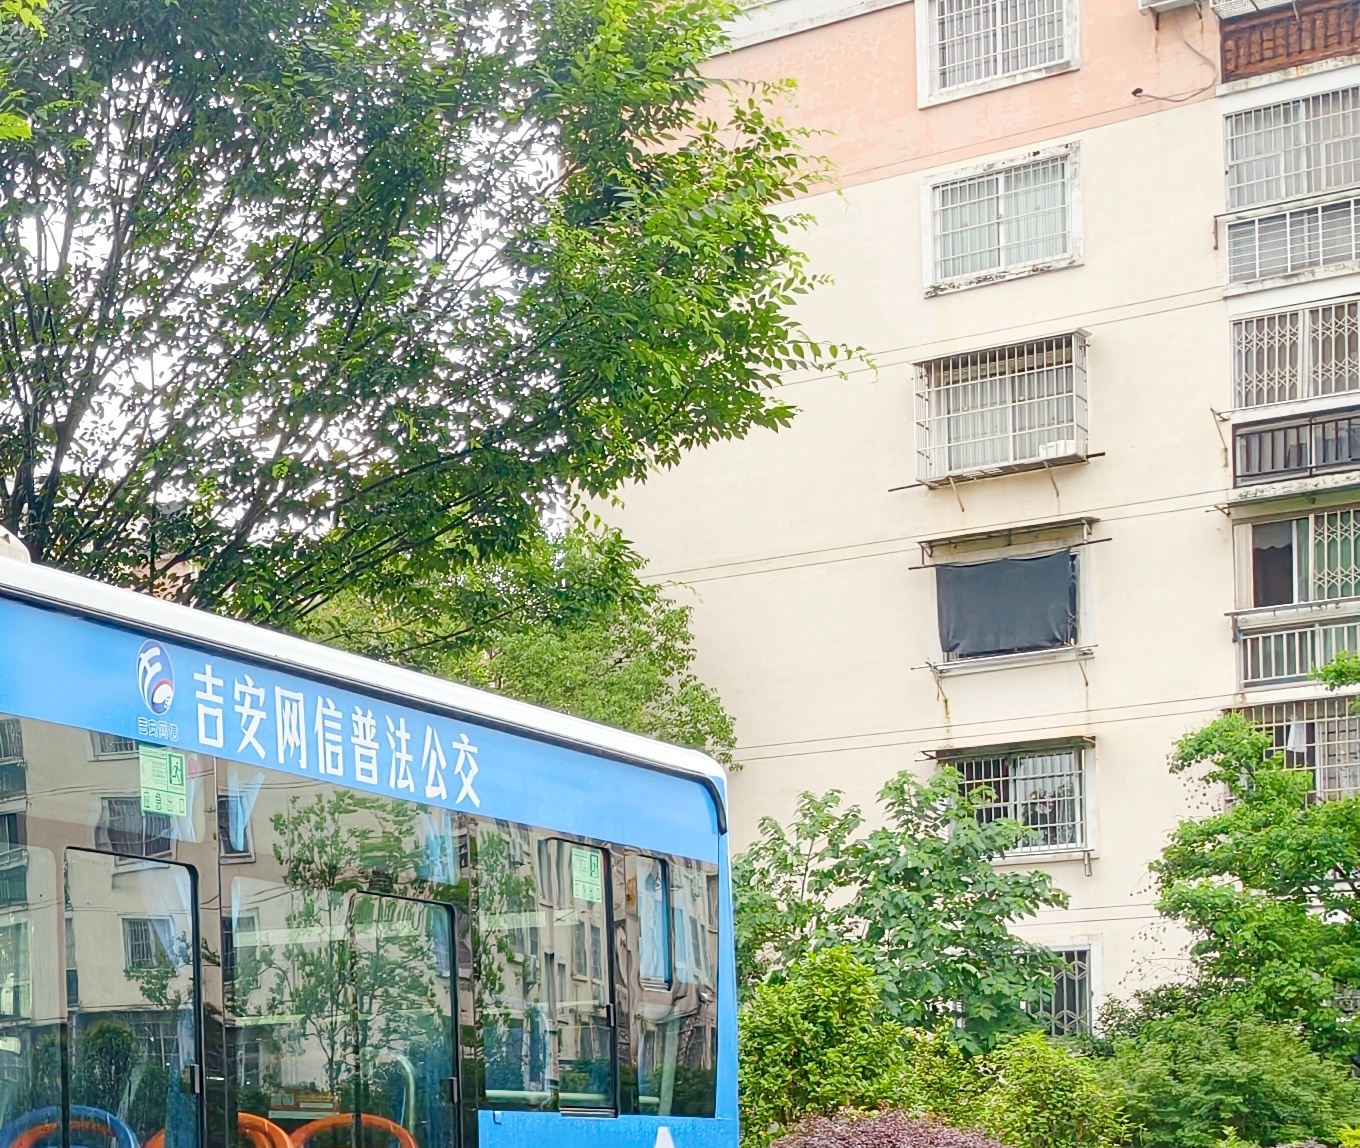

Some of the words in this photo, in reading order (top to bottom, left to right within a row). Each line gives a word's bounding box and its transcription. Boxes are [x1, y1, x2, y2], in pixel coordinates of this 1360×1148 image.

[193, 663, 481, 808] 吉安网信普法公交
